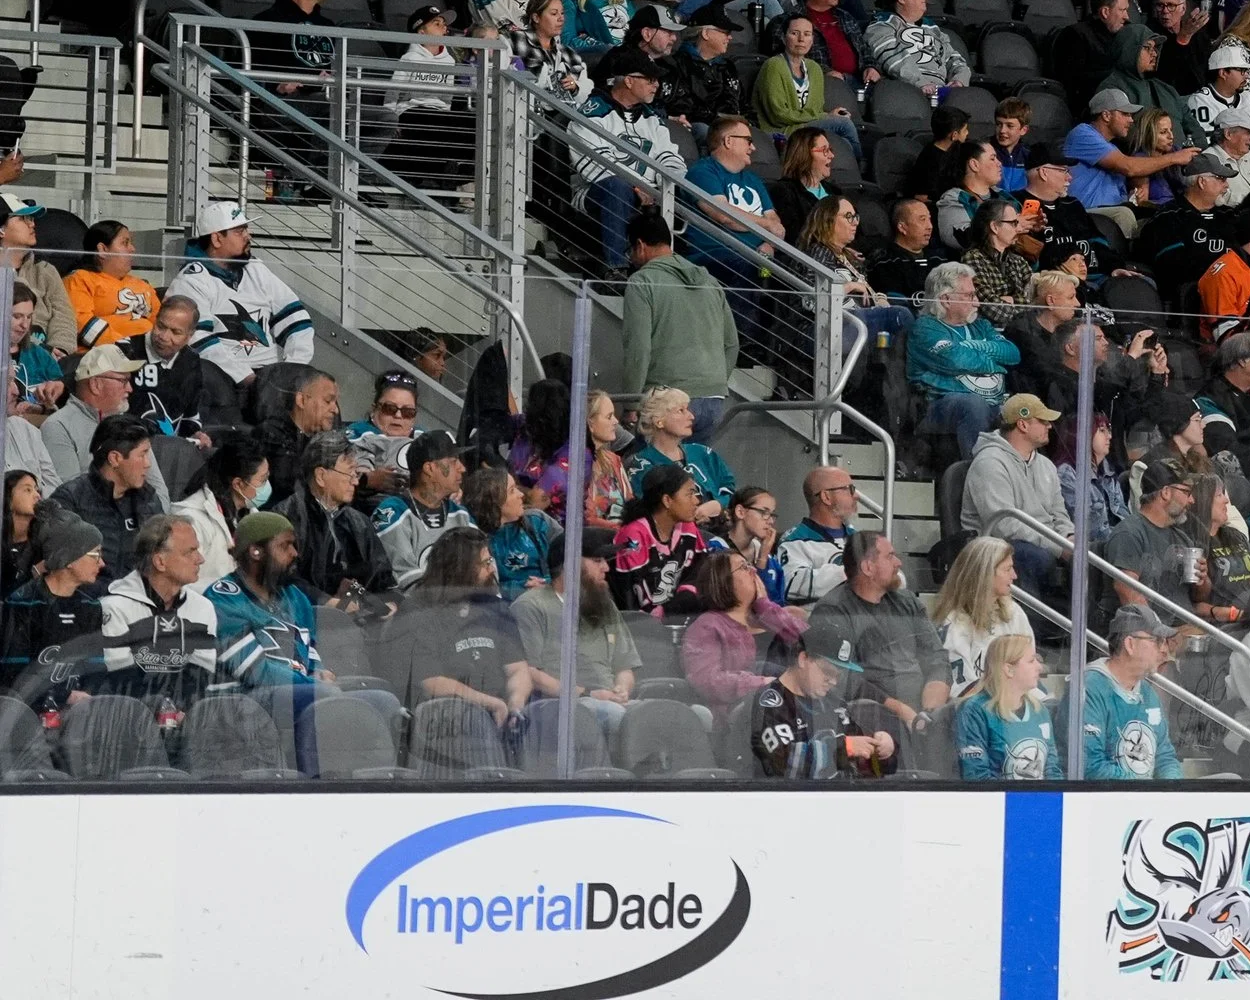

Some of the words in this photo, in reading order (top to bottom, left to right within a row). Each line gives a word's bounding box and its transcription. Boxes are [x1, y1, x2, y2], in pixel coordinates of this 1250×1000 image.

[415, 72, 442, 83] Hurley
[134, 646, 160, 664] San
[762, 723, 794, 753] 89
[397, 881, 703, 945] ImperialDade
